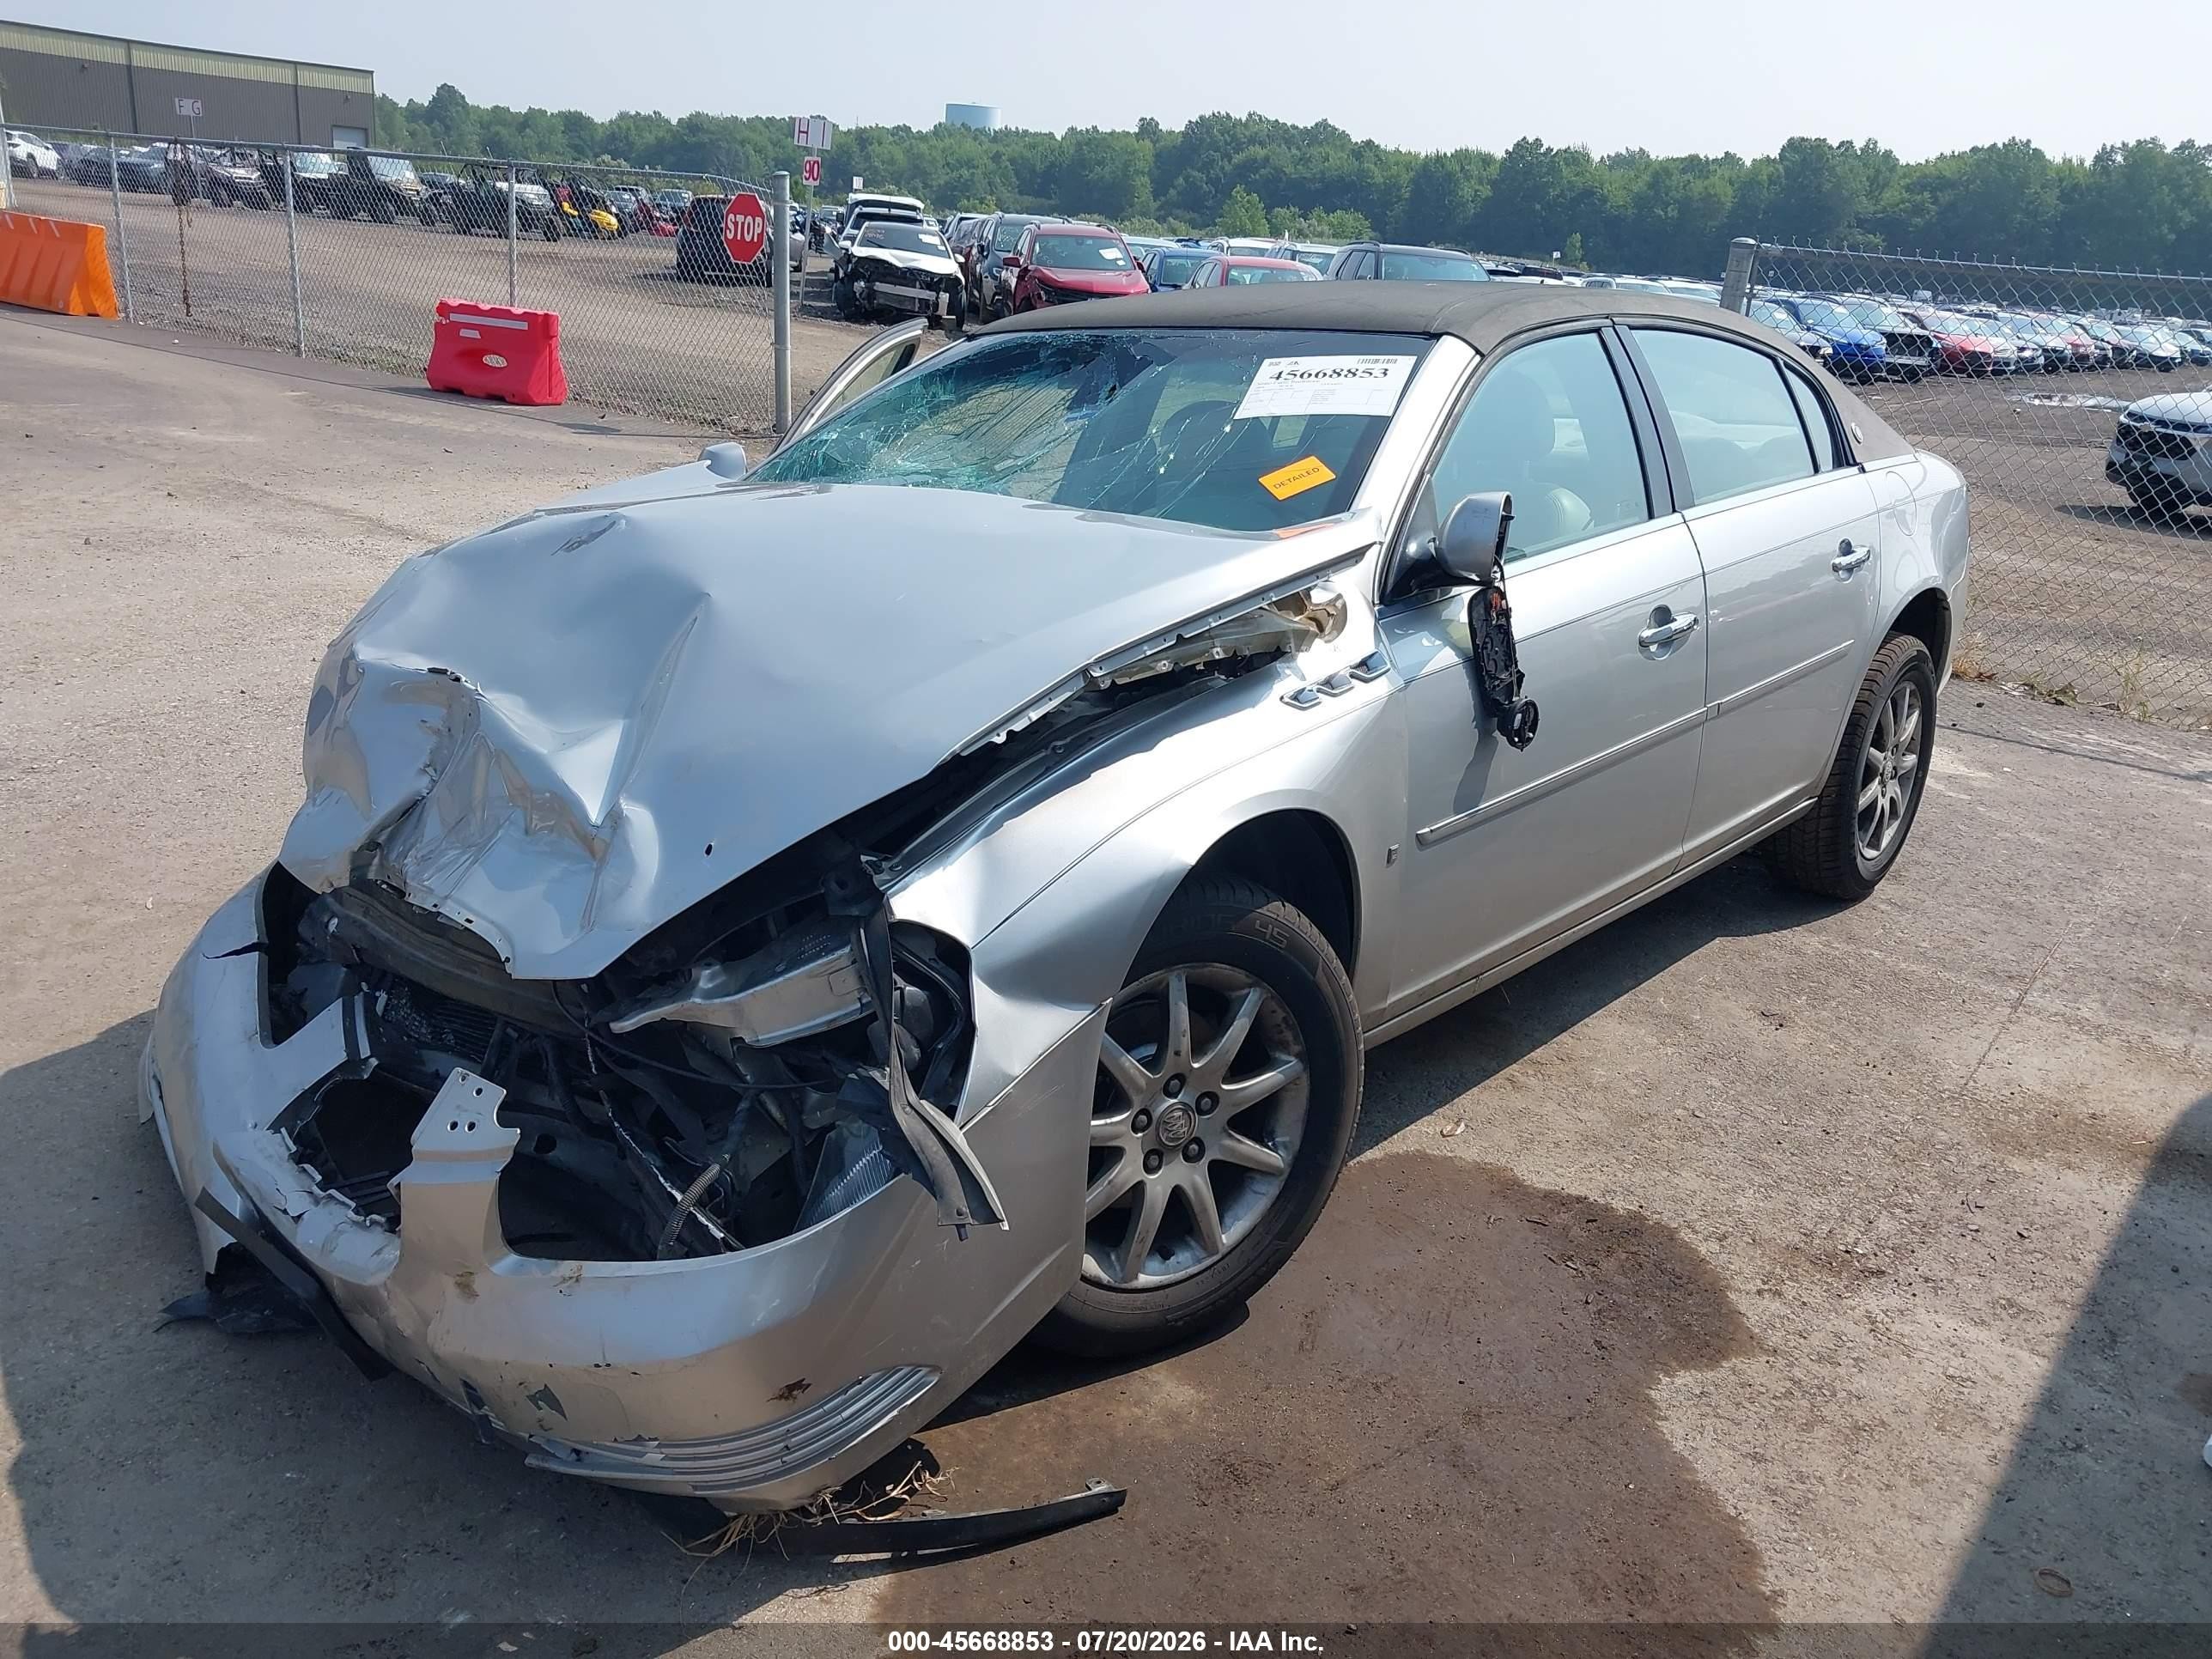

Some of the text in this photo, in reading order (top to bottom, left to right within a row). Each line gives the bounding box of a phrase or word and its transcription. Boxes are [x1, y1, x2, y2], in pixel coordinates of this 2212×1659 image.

[178, 99, 201, 115] F G
[797, 118, 810, 145] H
[804, 160, 820, 181] 90
[726, 213, 763, 242] STOP
[1269, 368, 1389, 381] 45668853
[1273, 467, 1321, 489] DETAILED
